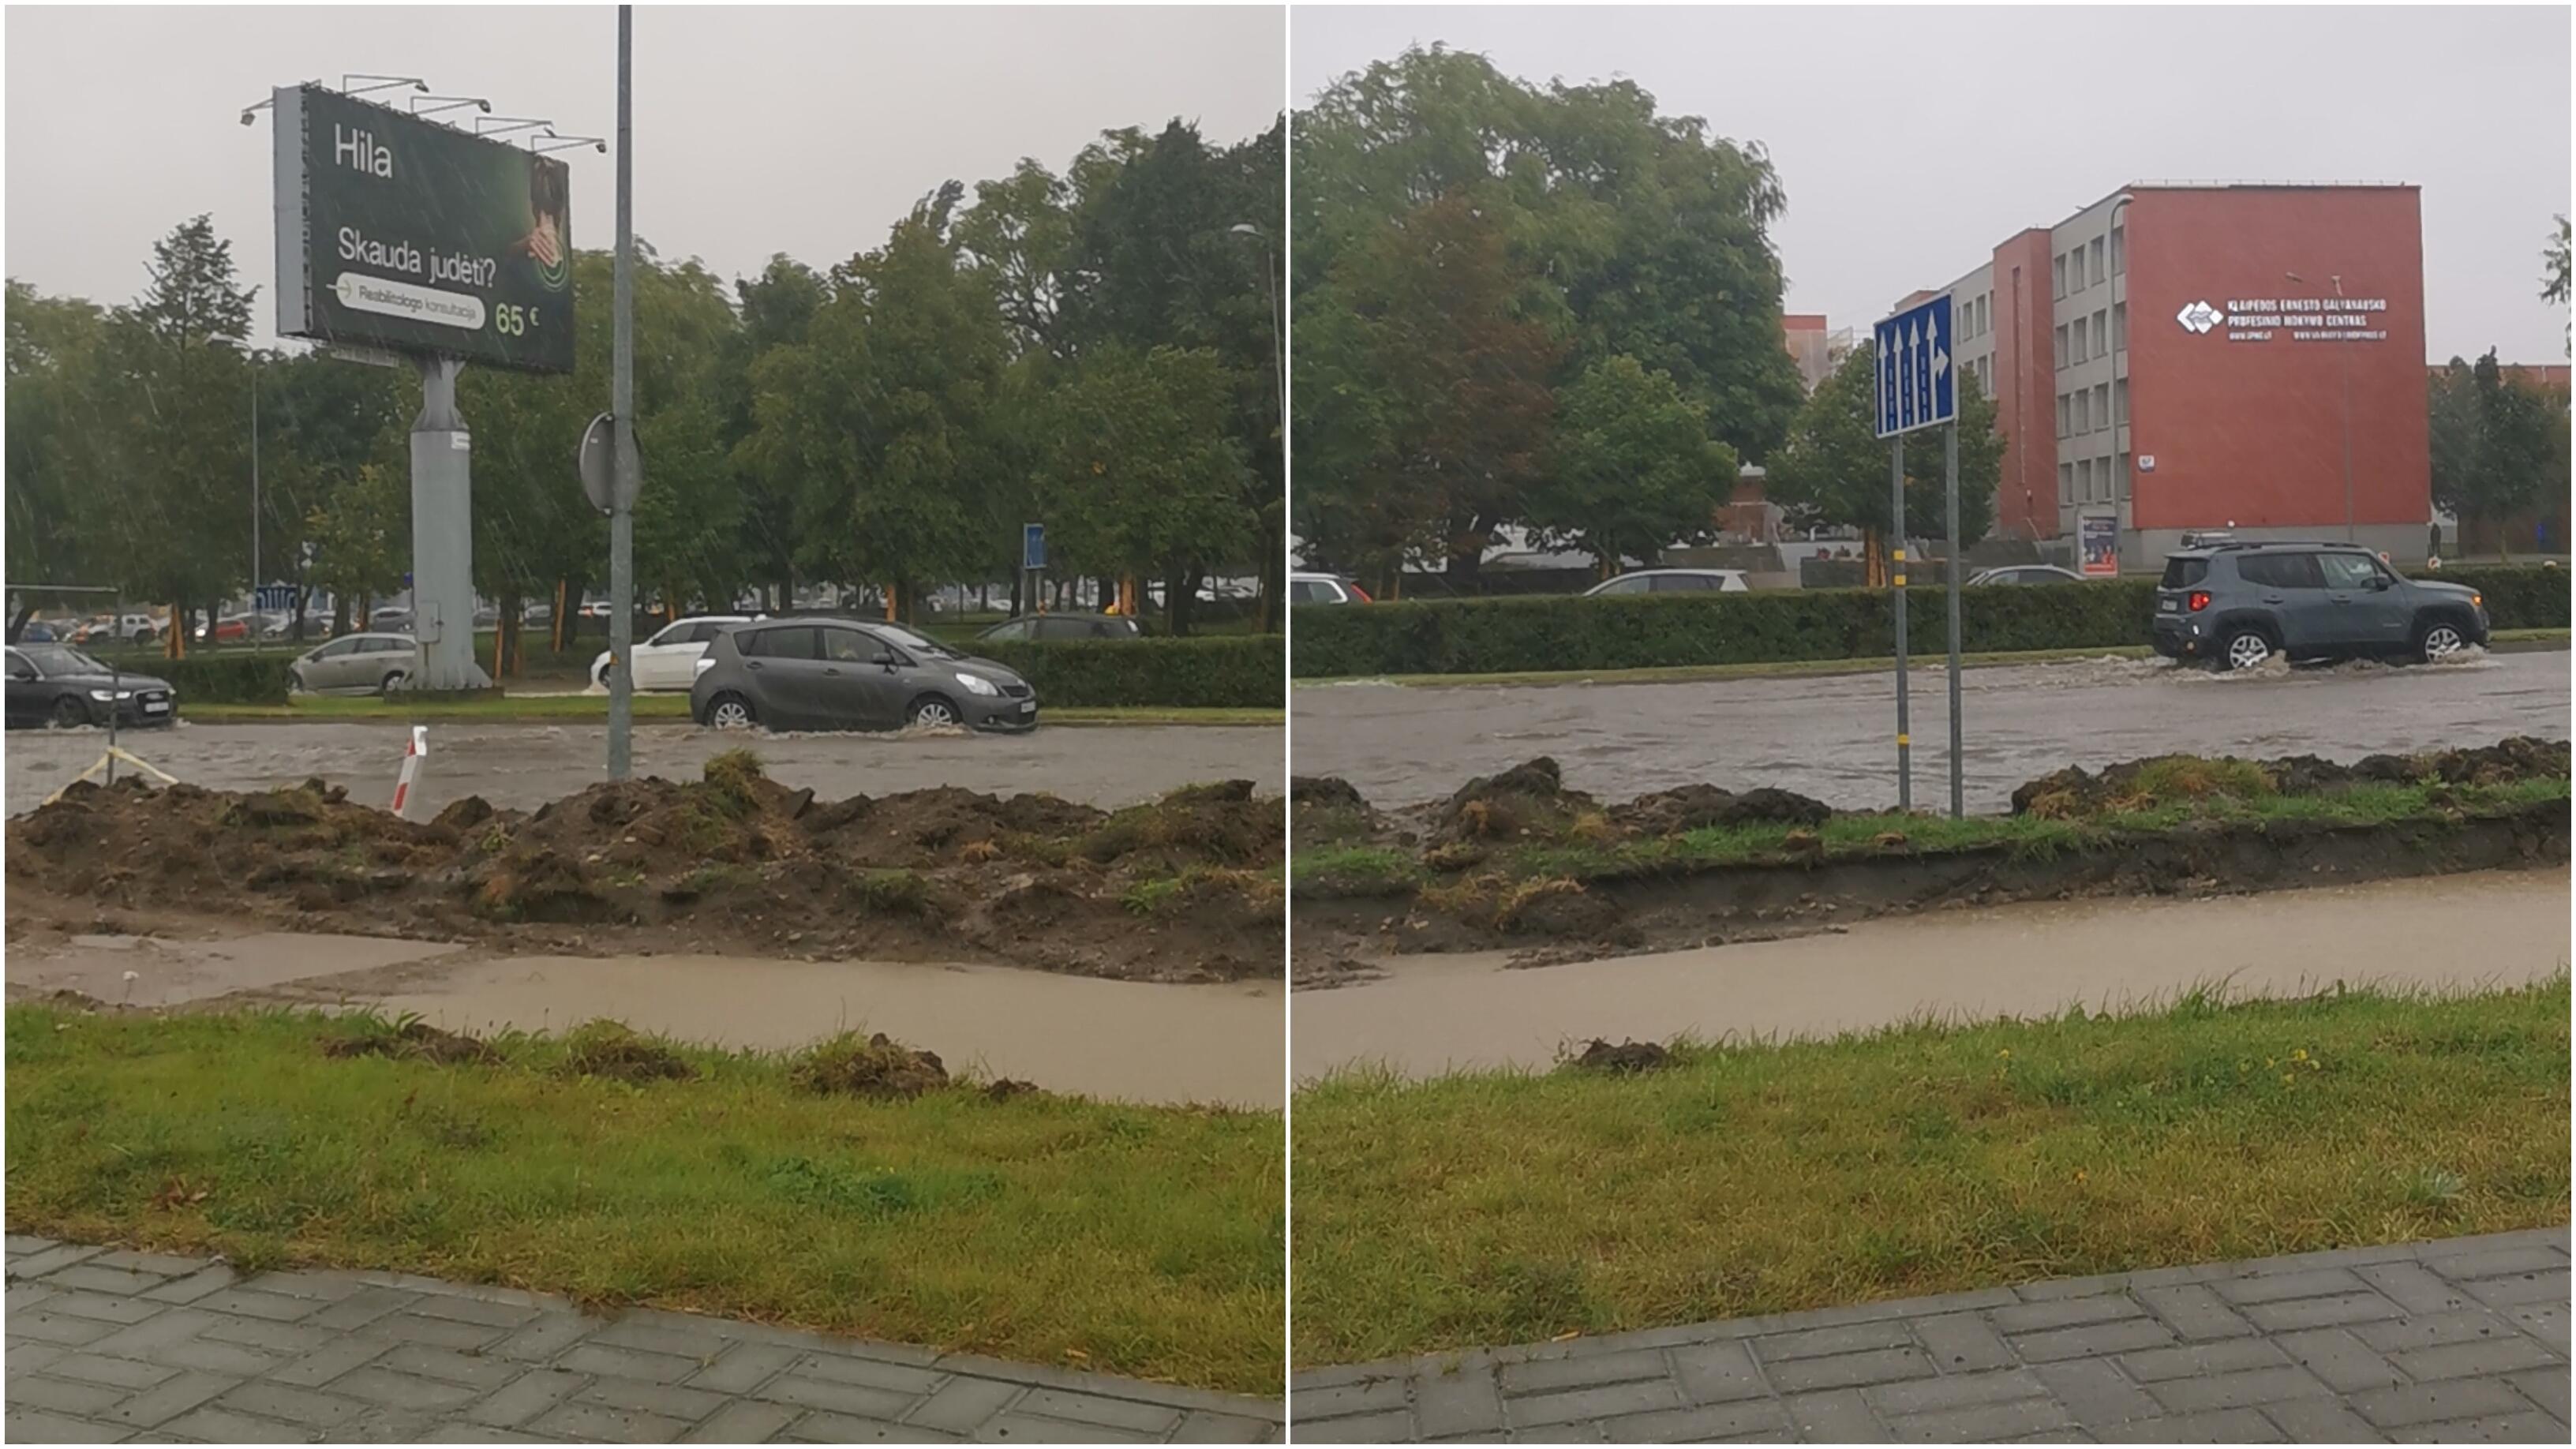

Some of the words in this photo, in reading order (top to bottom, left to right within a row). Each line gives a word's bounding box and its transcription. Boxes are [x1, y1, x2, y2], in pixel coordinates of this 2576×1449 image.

[335, 123, 392, 178] Hila
[338, 227, 421, 274] Skauda
[429, 247, 496, 287] judėti?
[496, 303, 525, 335] 65
[530, 306, 540, 326] €
[2326, 314, 2368, 327] CENTRAS
